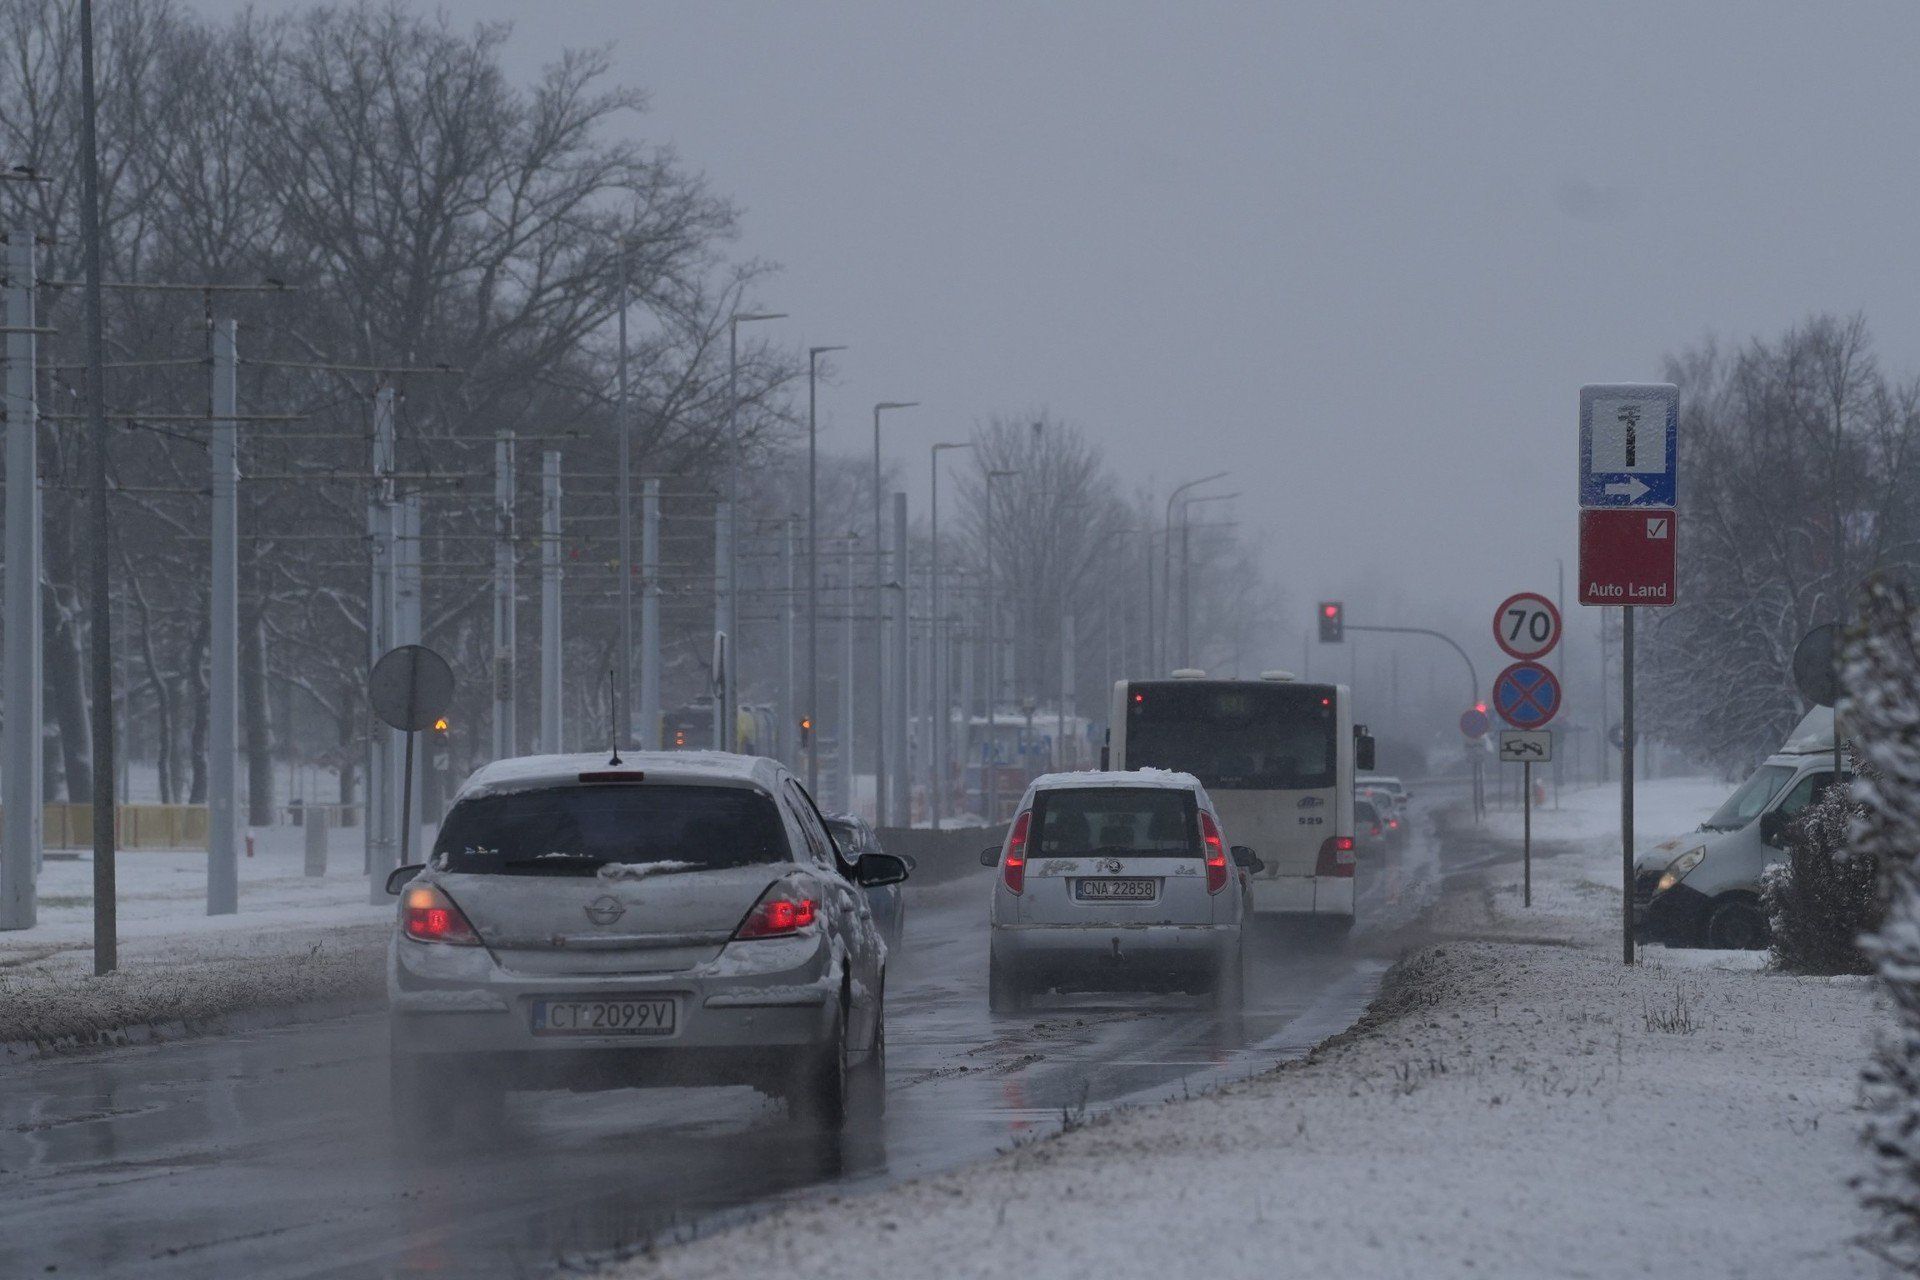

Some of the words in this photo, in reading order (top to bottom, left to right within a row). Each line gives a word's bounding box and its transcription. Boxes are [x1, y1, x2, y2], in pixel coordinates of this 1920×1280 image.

[1588, 582, 1624, 597] Auto
[1628, 582, 1667, 597] Land
[1508, 610, 1551, 642] 70
[1083, 881, 1109, 896] CNA
[1112, 881, 1153, 896] 22858
[551, 1003, 581, 1028] CT
[592, 1003, 666, 1028] 2099V
